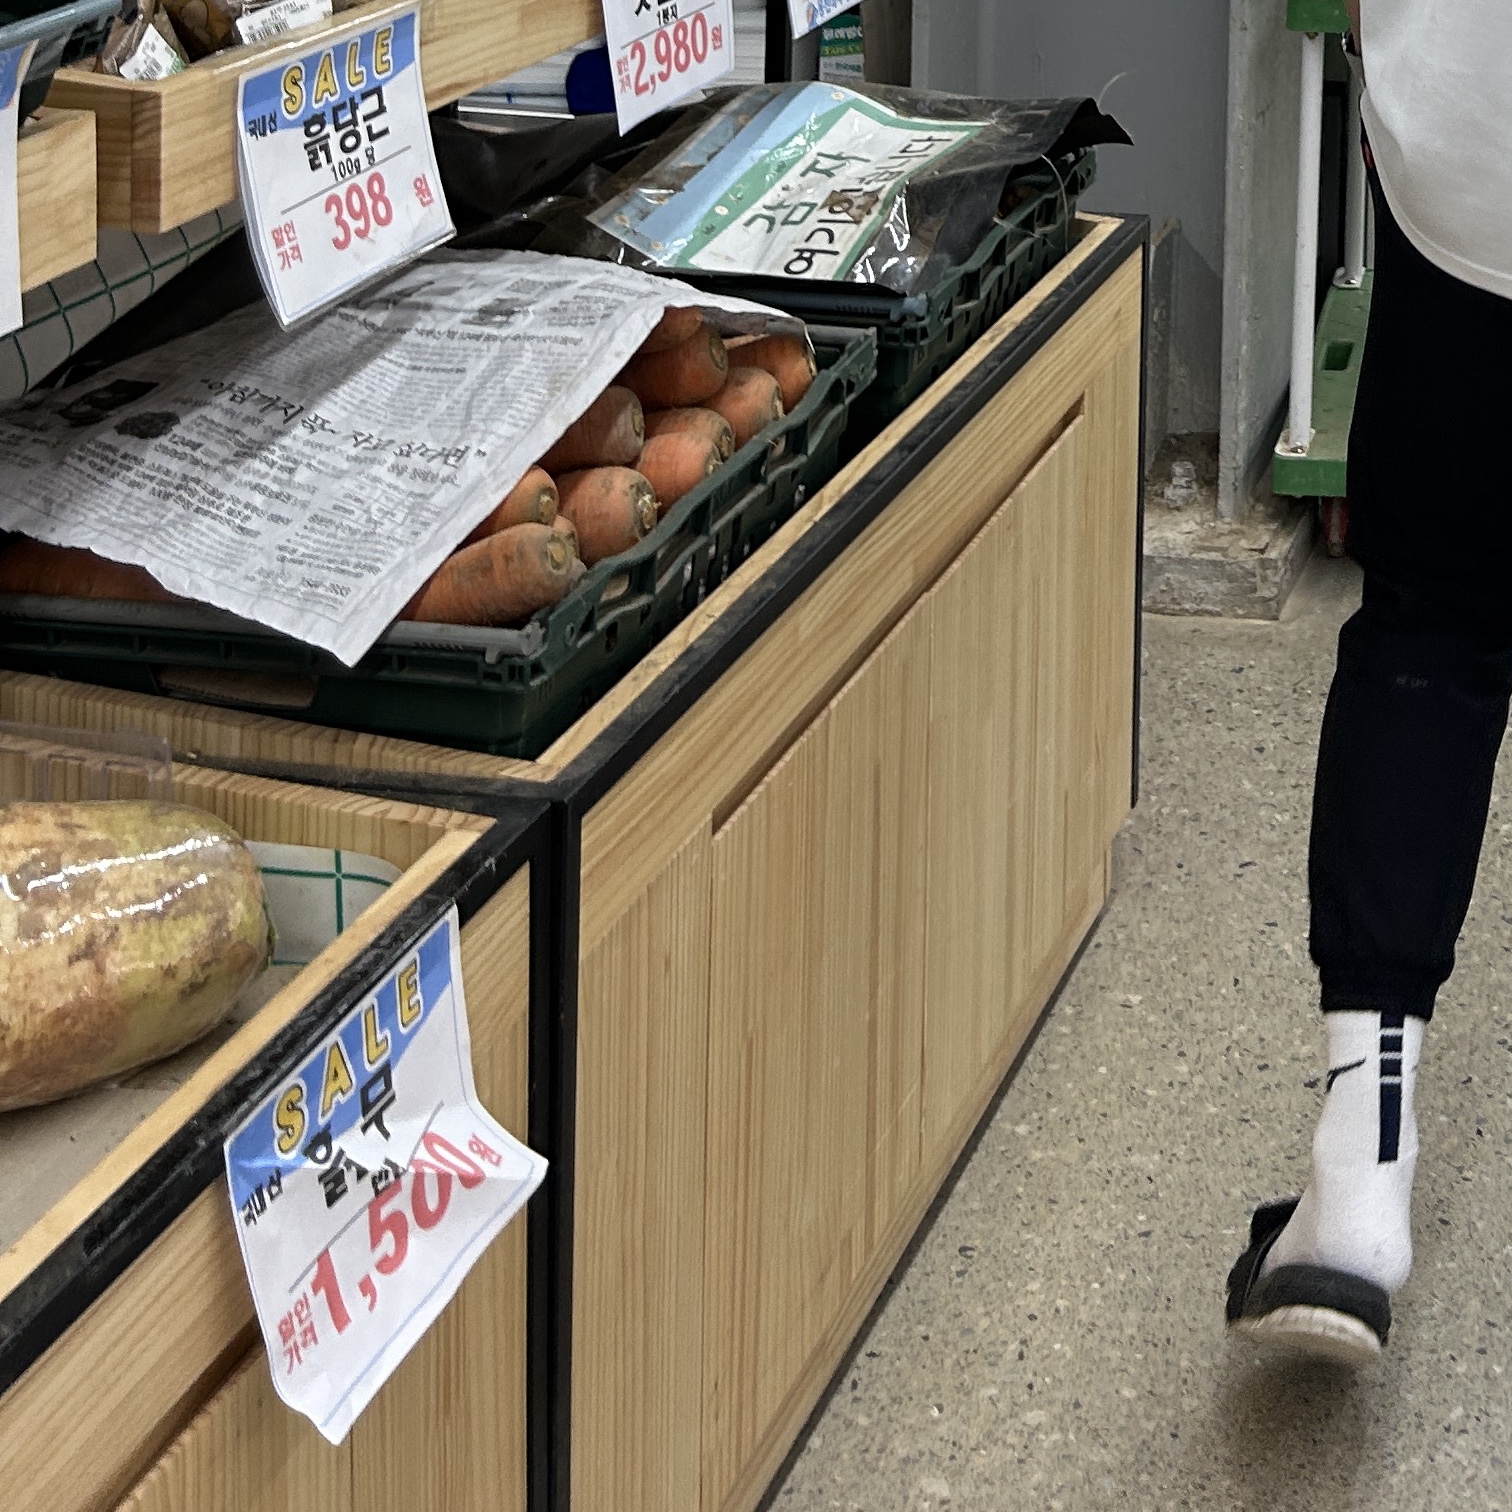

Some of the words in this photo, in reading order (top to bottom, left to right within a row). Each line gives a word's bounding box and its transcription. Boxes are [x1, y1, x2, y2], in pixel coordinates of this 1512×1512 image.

[282, 26, 394, 116] SALE
[630, 11, 709, 97] 2,980
[303, 85, 390, 172] 흙당근
[325, 171, 394, 251] 398
[412, 174, 434, 208] 원
[273, 963, 422, 1157] SALE
[309, 1130, 485, 1335] 1,500
